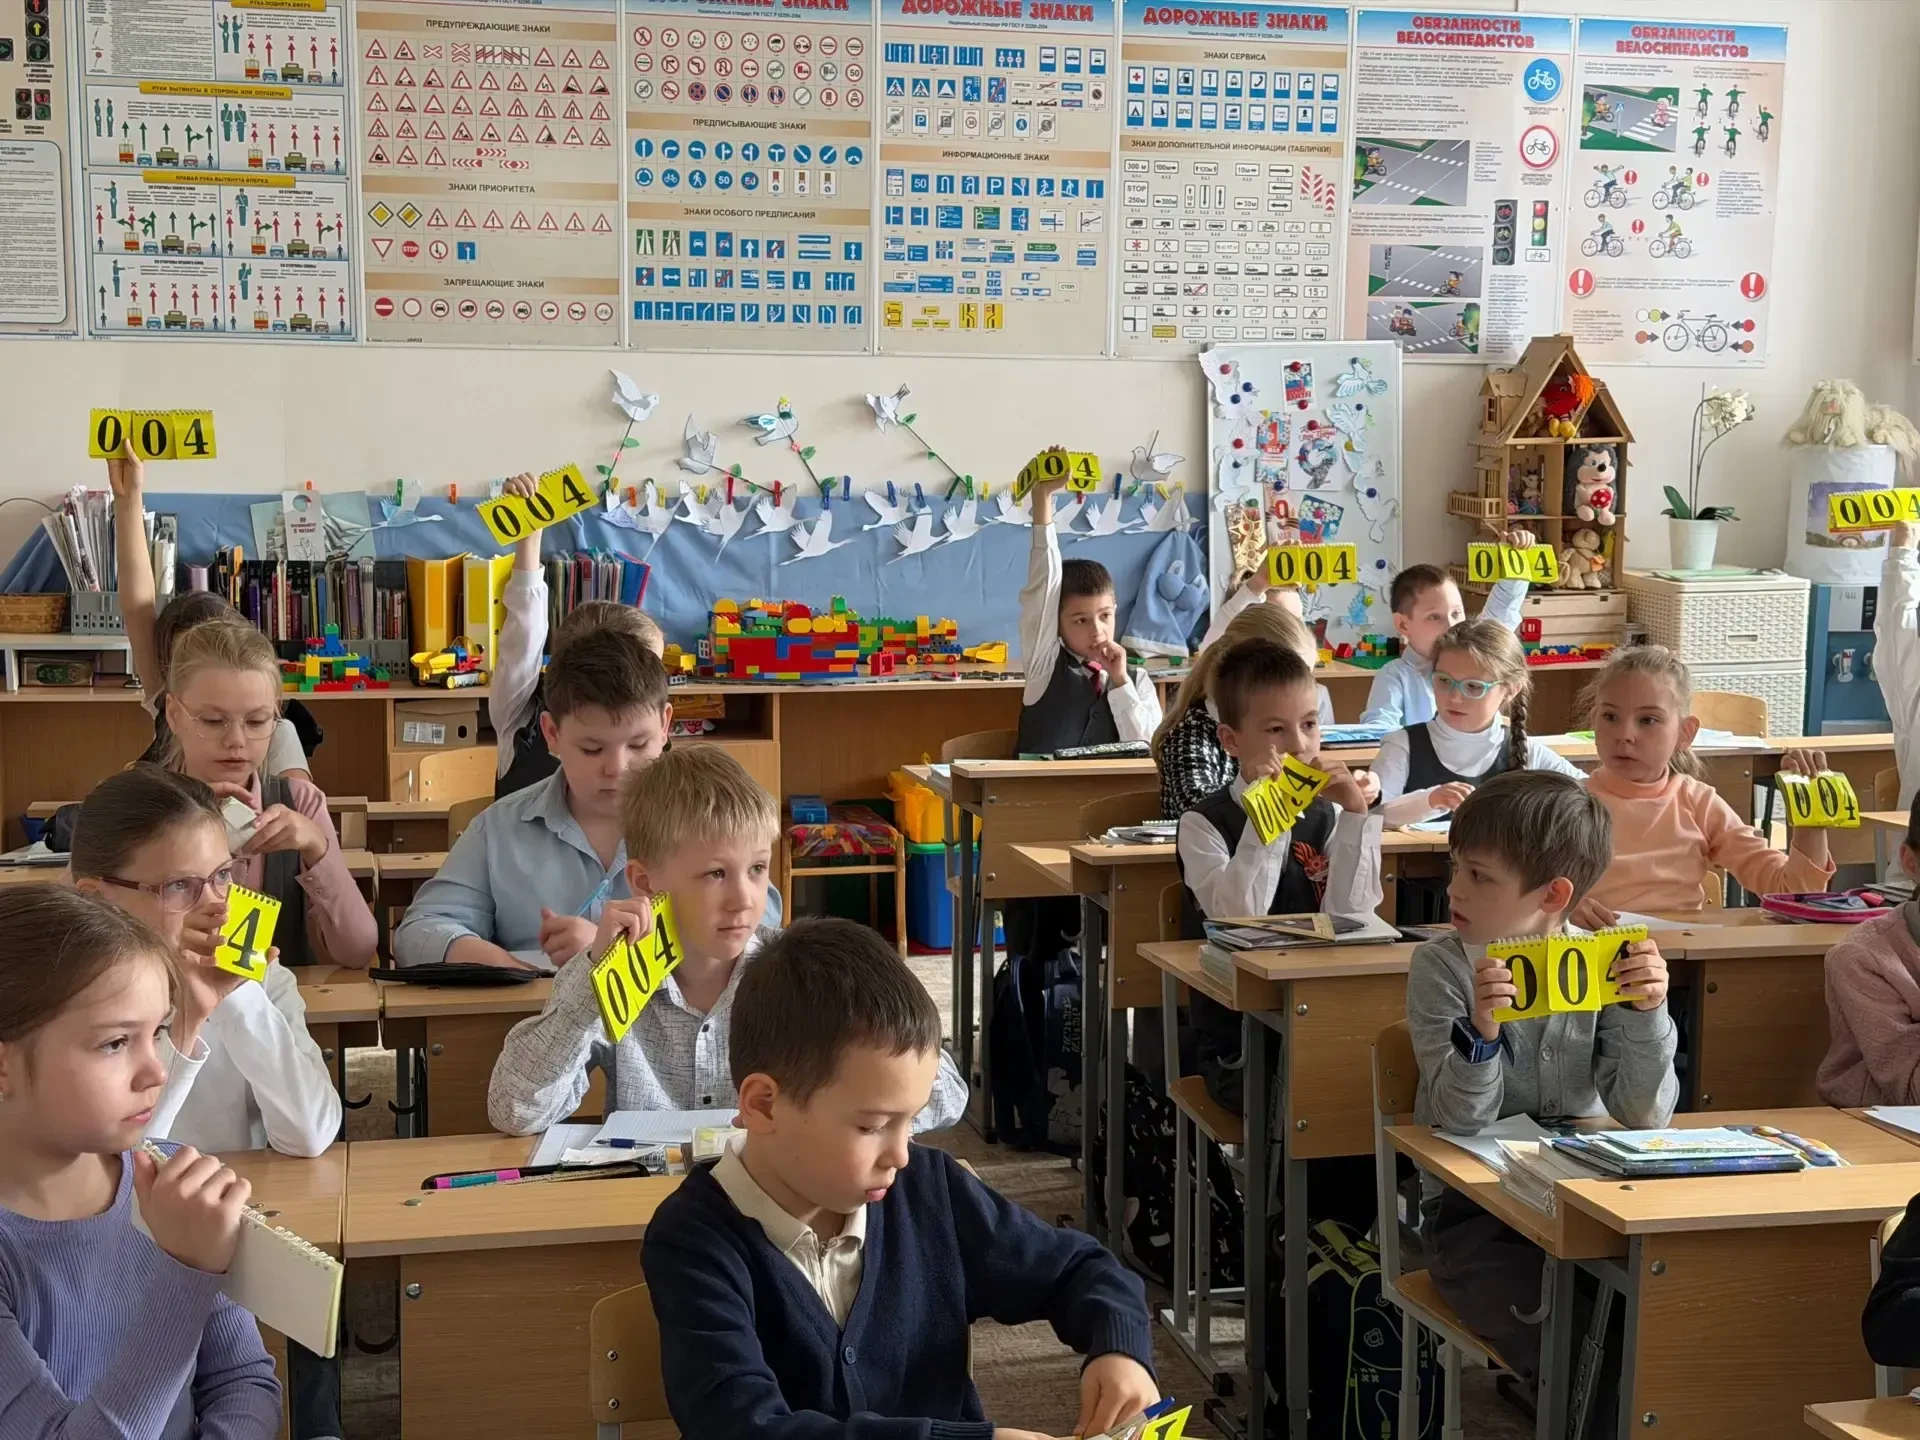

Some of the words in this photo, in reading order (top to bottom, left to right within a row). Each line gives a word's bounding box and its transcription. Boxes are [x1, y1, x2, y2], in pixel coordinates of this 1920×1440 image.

[901, 0, 1022, 19] ДОРОЖНЫЕ
[1029, 2, 1094, 22] ЗНАКИ
[1143, 7, 1260, 28] ДОРОЖНЫЕ
[1265, 14, 1328, 31] ЗНАКИ
[426, 19, 521, 32] ПРЕДУПРЕЖДАЮЩИЕ
[522, 24, 551, 33] ЗНАКИ
[1412, 16, 1522, 33] ОБЯЗАННОСТИ
[1396, 31, 1535, 49] ВЕЛОСИПЕДИСТОВ
[1631, 26, 1736, 43] ОБЯЗАННОСТИ
[1203, 52, 1229, 60] ЗНАКИ
[1230, 53, 1266, 61] СЕРВИСА
[1616, 40, 1749, 58] ВЕЛОСИПЕДИСТОВ
[692, 118, 778, 130] ПРЕДПИСЫВАЮЩИЕ
[779, 122, 807, 130] ЗНАКИ
[942, 150, 1022, 160] ИНФОРМАЦИОННЫЕ
[1023, 153, 1050, 161] ЗНАКИ
[1131, 140, 1157, 148] ЗНАКИ
[1157, 141, 1231, 151] ДОПОЛНИТЕЛЬНОЙ
[1232, 143, 1286, 153] ИНФОРМАЦИИ
[1287, 145, 1332, 154] (ТАБЛИЧКИ)
[448, 183, 477, 191] ЗНАКИ
[479, 184, 535, 193] ПРИОРИТЕТА
[718, 176, 730, 184] 50
[914, 178, 927, 189] 50
[683, 208, 711, 216] ЗНАКИ
[713, 208, 754, 218] ОСОБОГО
[755, 209, 816, 219] ПРЕДПИСАНИЯ
[402, 245, 419, 253] STOP
[443, 278, 515, 288] ЗАПРЕЩАЮЩИЕ
[516, 280, 545, 288] ЗНАКИ
[1308, 288, 1319, 296] 15
[97, 415, 210, 457] 004
[1020, 455, 1097, 491] 004
[491, 473, 591, 538] 004
[1275, 551, 1351, 581] 004
[1474, 548, 1553, 579] 004
[1255, 764, 1323, 834] 004
[1791, 776, 1857, 821] 004
[227, 906, 262, 972] 4
[606, 912, 678, 1026] 004
